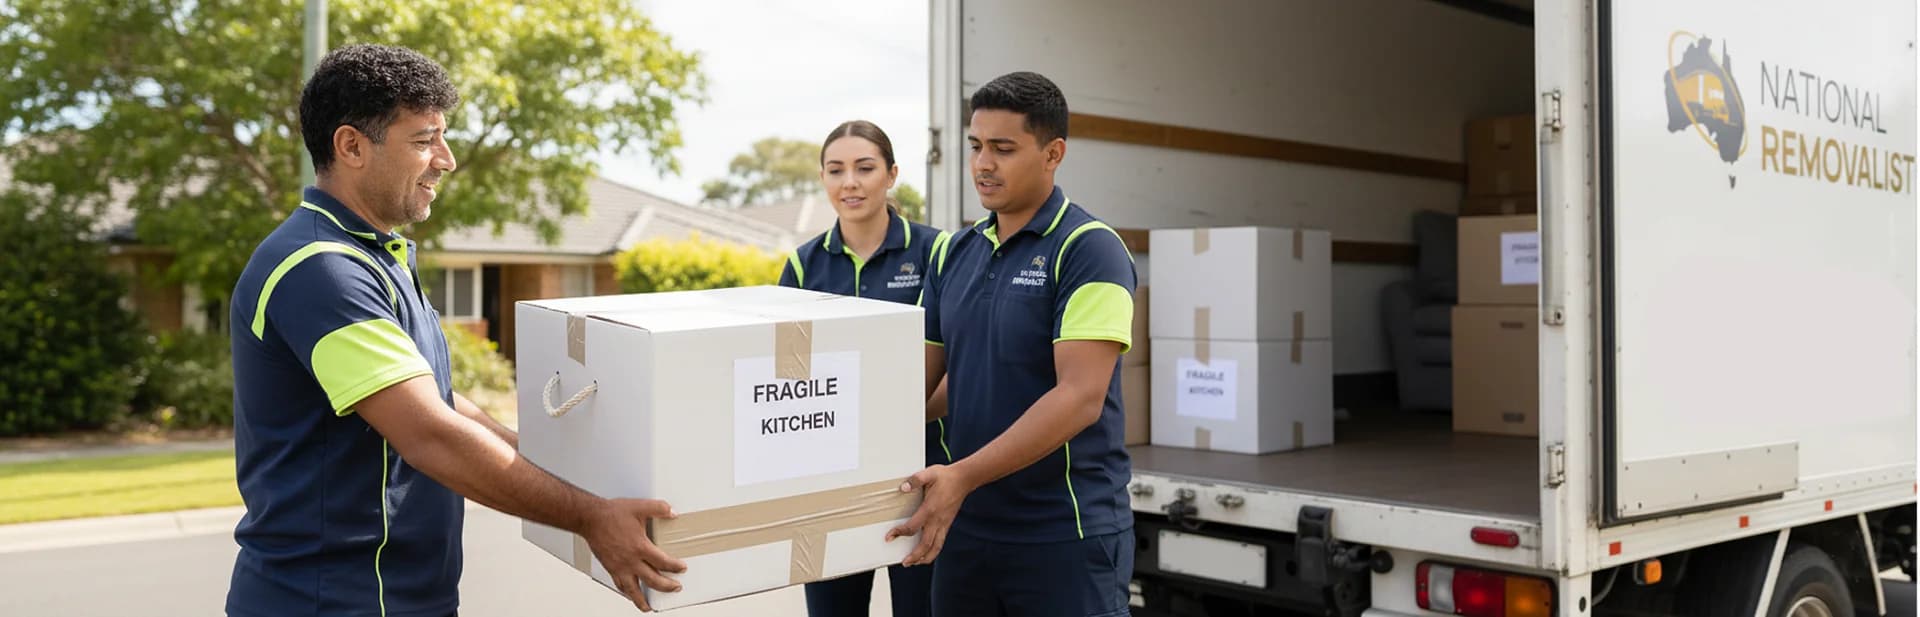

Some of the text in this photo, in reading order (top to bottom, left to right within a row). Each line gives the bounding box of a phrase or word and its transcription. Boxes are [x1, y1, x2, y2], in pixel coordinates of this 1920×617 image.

[1761, 60, 1887, 134] NATIONAL
[1761, 125, 1915, 195] REMOVALIST
[754, 377, 838, 403] FRAGILE
[761, 411, 835, 435] KITCHEN
